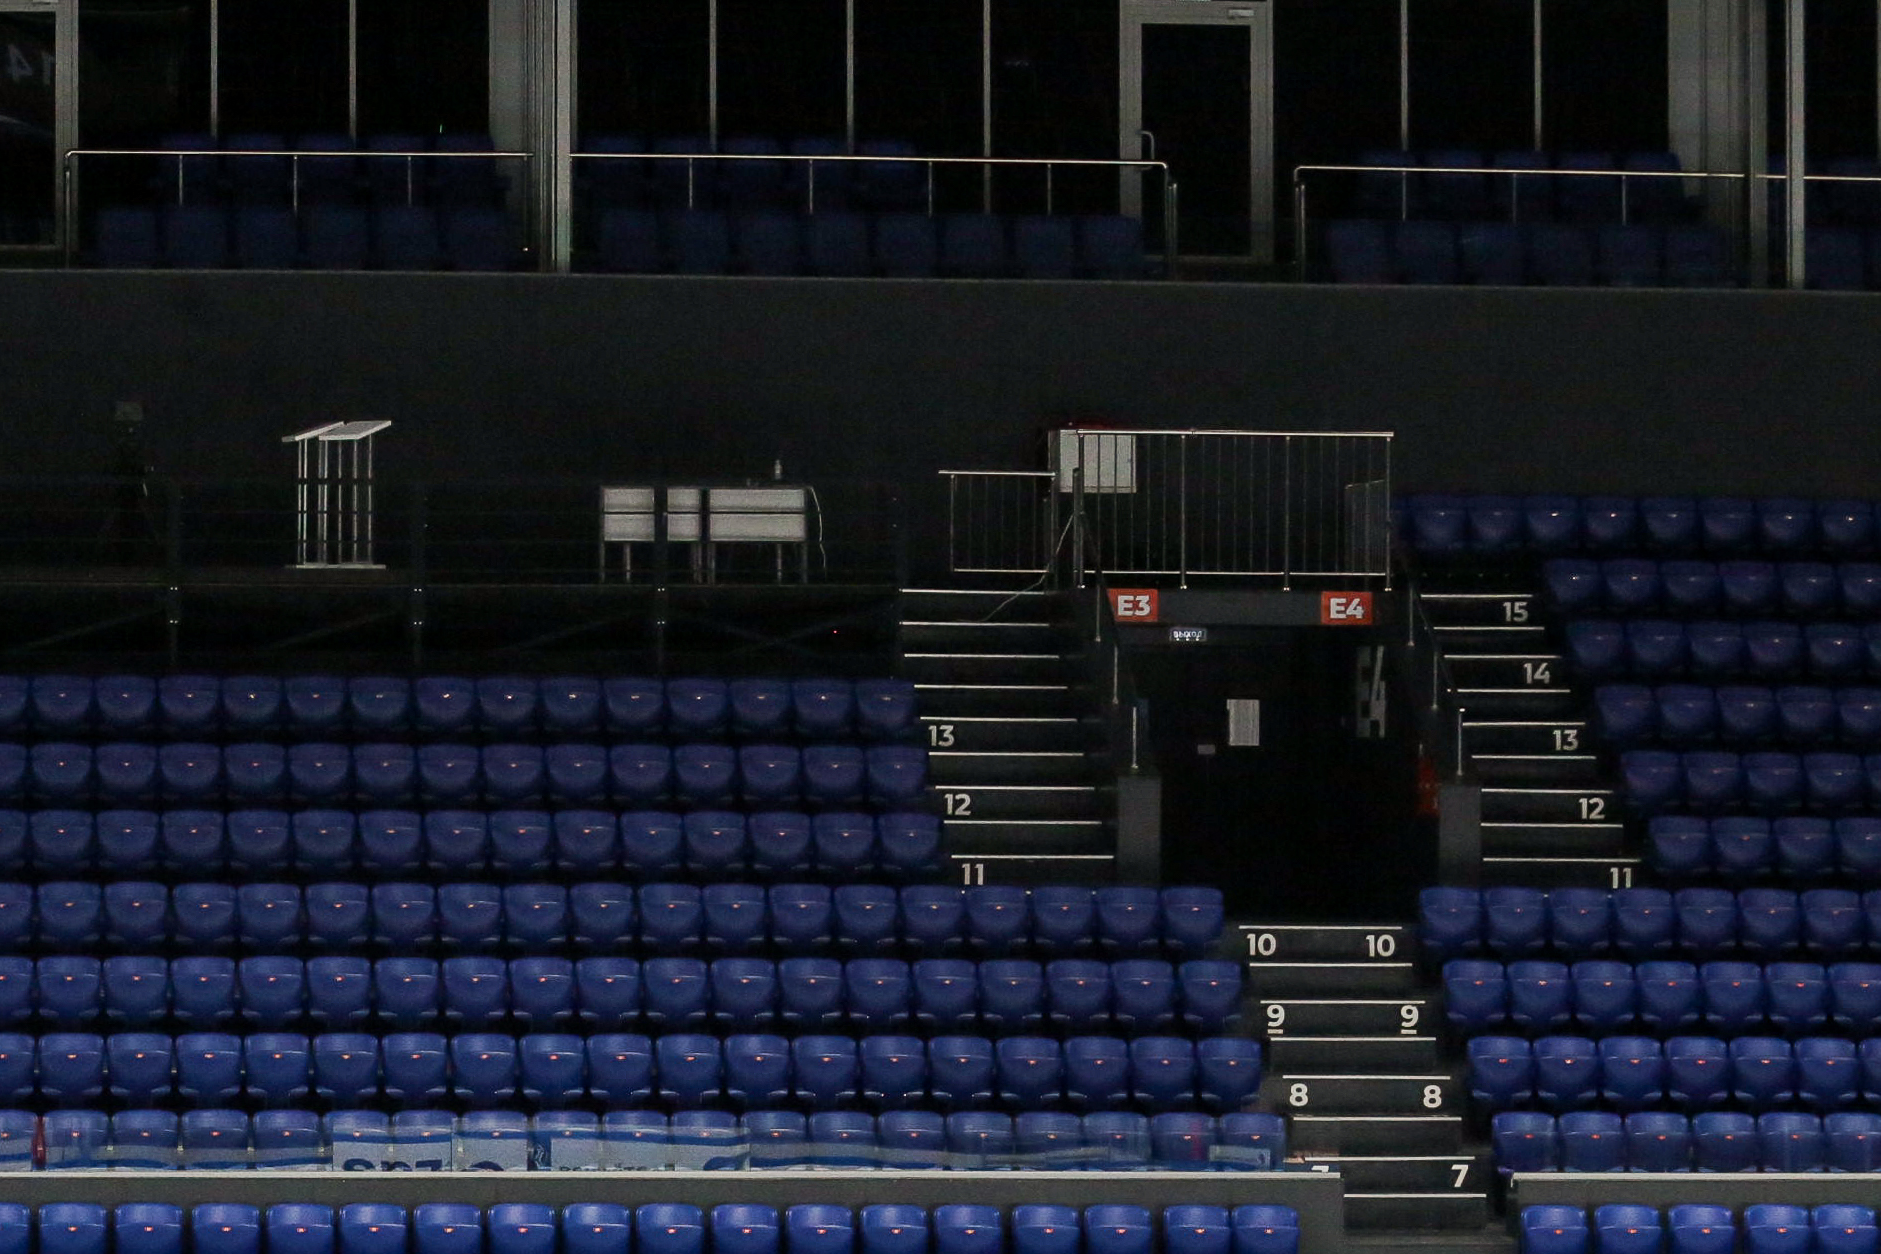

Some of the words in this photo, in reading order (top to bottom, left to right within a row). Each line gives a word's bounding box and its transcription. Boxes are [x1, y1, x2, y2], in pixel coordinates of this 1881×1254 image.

[1118, 595, 1150, 615] E3
[1330, 598, 1363, 618] E4
[1503, 602, 1527, 621] 15
[1524, 663, 1549, 683] 14
[929, 725, 954, 746] 13
[1553, 730, 1577, 750] 13
[945, 794, 971, 815] 12
[1579, 798, 1604, 819] 12
[962, 864, 983, 885] 11
[1611, 868, 1631, 888] 11
[1247, 934, 1276, 955] 10
[1366, 935, 1395, 956] 10
[1267, 1005, 1285, 1027] 9
[1400, 1005, 1419, 1028] 9
[1290, 1083, 1308, 1106] 8
[1423, 1085, 1441, 1108] 8
[1452, 1164, 1468, 1187] 7
